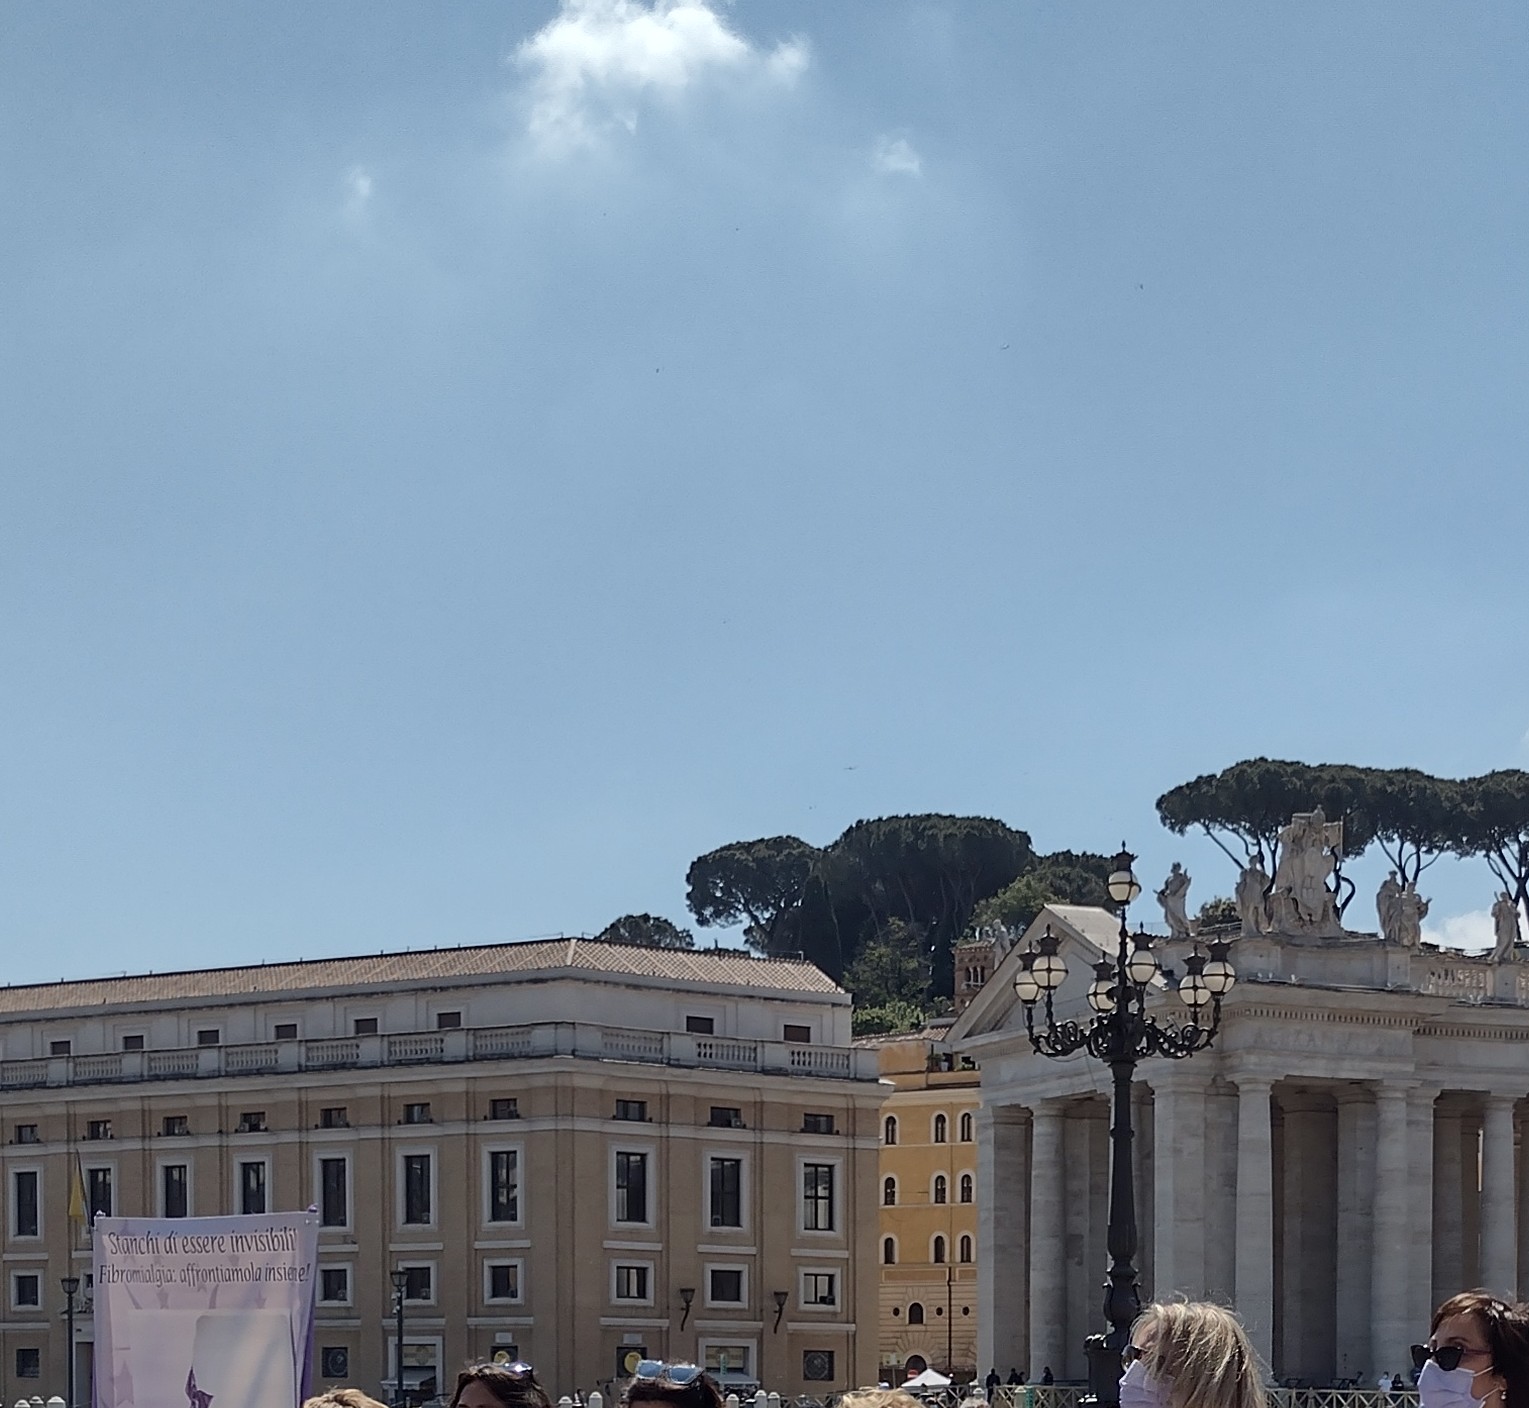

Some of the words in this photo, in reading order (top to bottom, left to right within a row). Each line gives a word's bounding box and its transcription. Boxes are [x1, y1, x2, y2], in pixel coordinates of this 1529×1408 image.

[108, 1231, 160, 1255] Stanchi
[164, 1231, 178, 1254] di
[181, 1232, 226, 1254] essere
[99, 1264, 177, 1288] Fibromialgia:
[179, 1262, 263, 1288] affrontiamola
